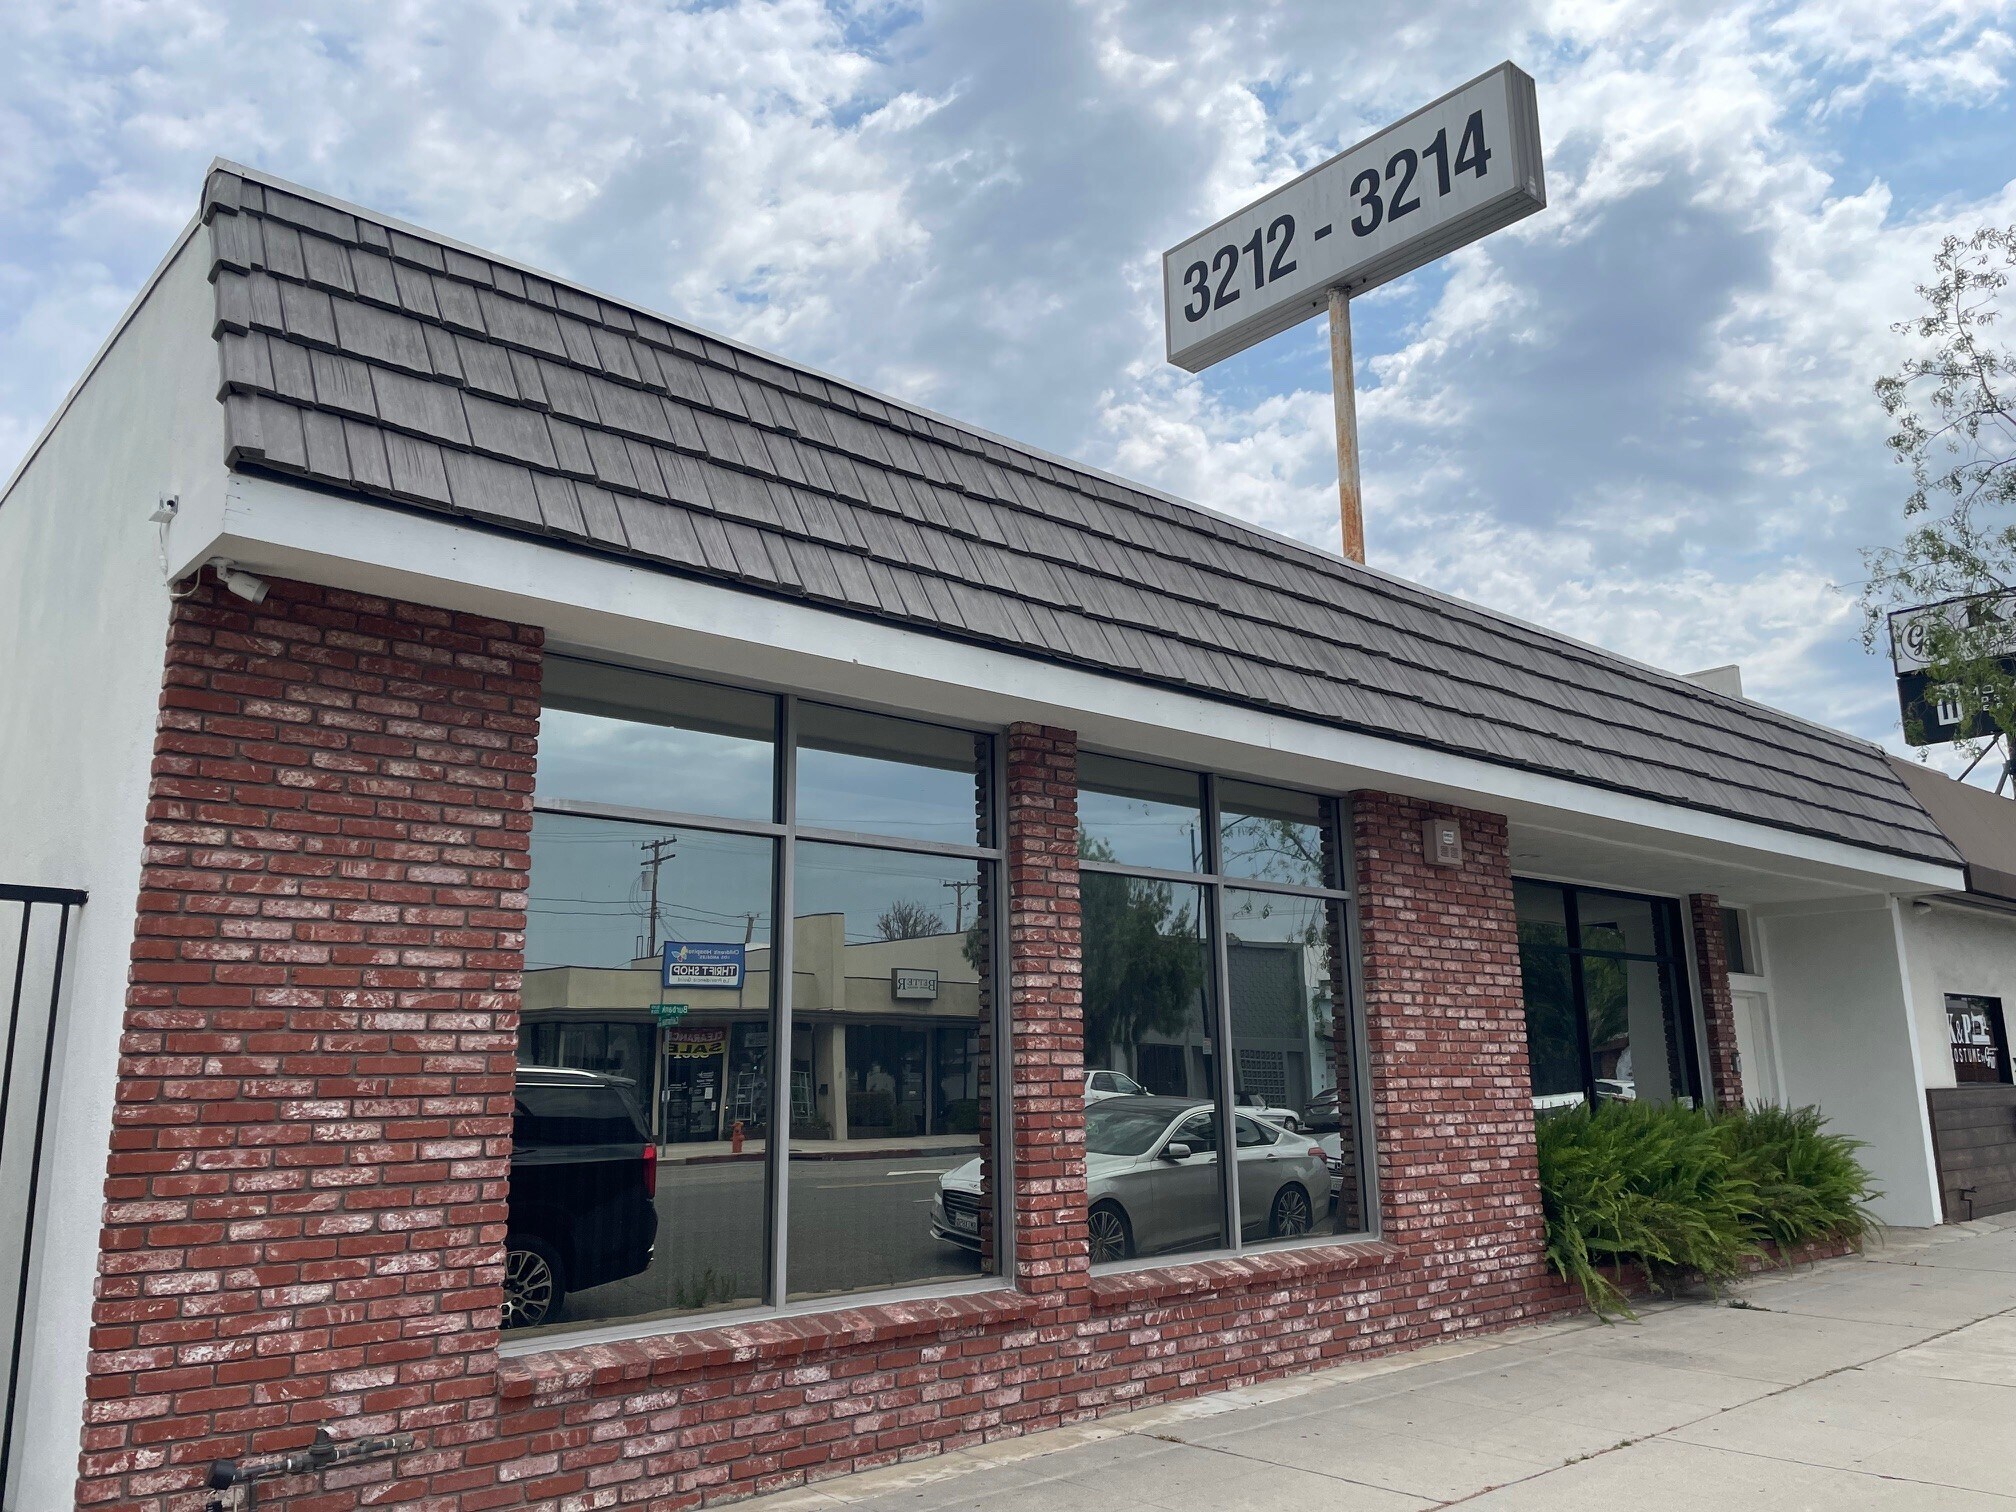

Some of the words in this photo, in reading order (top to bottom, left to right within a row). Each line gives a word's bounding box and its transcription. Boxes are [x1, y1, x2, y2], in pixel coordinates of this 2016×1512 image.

[1183, 213, 1297, 323] 3212
[1314, 223, 1332, 241] -
[1349, 109, 1492, 237] 3214
[1953, 1047, 1981, 1063] OSTUME
